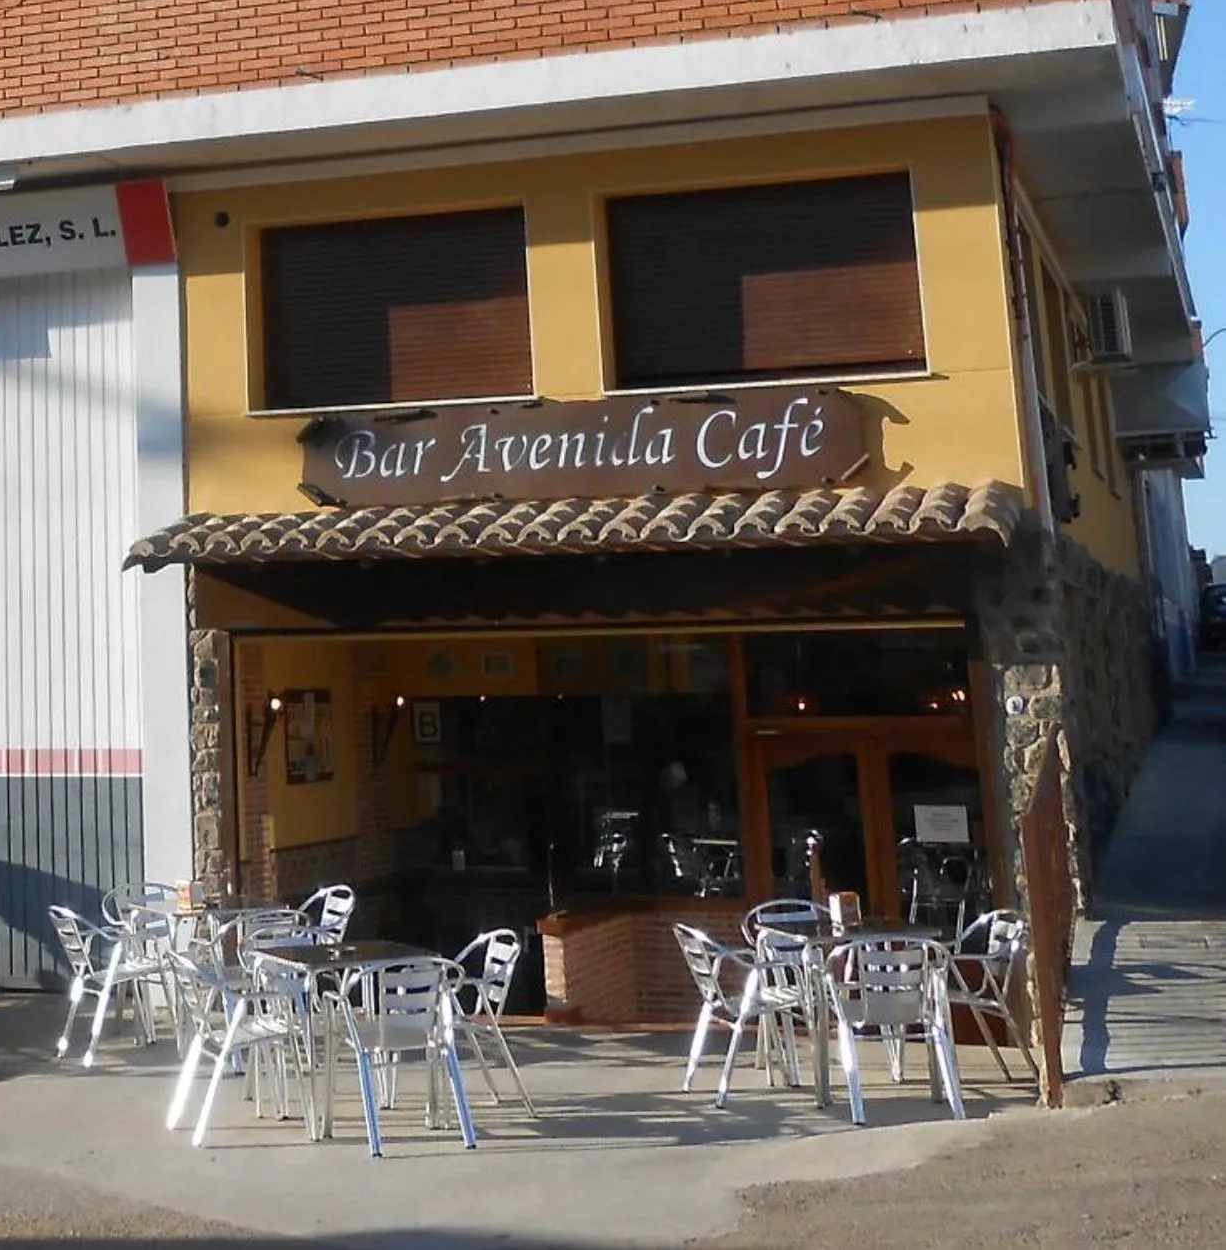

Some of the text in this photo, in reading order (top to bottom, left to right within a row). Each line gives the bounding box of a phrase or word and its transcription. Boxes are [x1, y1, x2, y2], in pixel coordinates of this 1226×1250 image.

[334, 397, 826, 483] Bar Avenida Café
